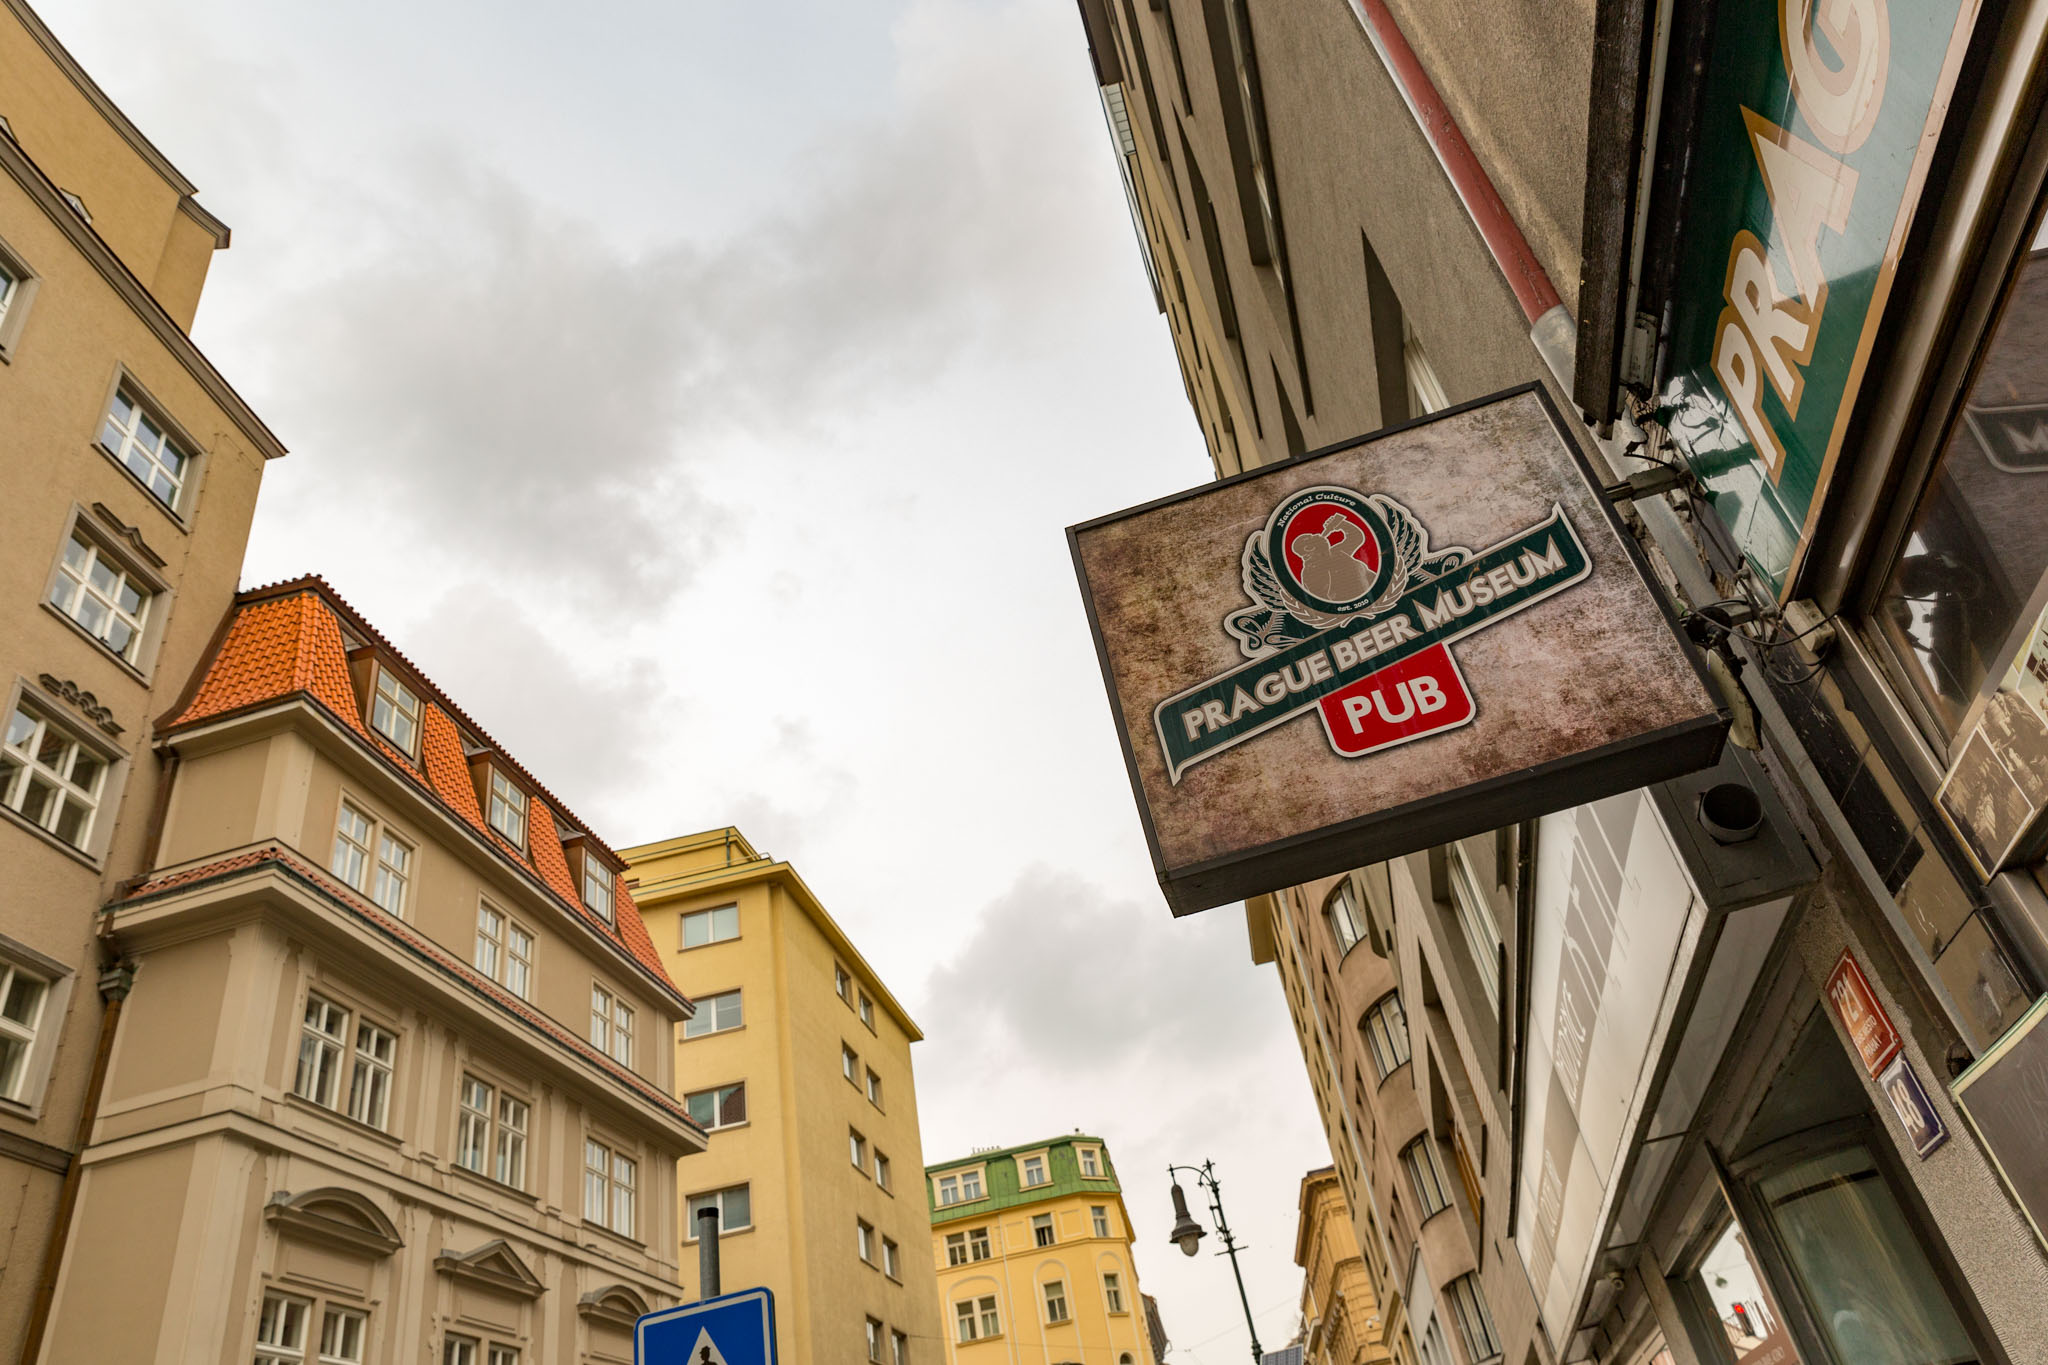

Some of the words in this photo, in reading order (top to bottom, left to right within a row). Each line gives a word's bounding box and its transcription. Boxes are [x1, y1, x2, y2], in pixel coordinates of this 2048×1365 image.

[1277, 496, 1313, 528] National
[1315, 493, 1356, 507] Culture
[1337, 604, 1353, 612] est.
[1353, 598, 1369, 609] 2010
[1182, 649, 1334, 741] PRAGUE
[1330, 613, 1424, 673] BEER
[1412, 534, 1567, 632] MUSEUM
[1342, 675, 1447, 735] PUB
[1831, 972, 1864, 1029] 721
[1891, 1078, 1926, 1134] 48
